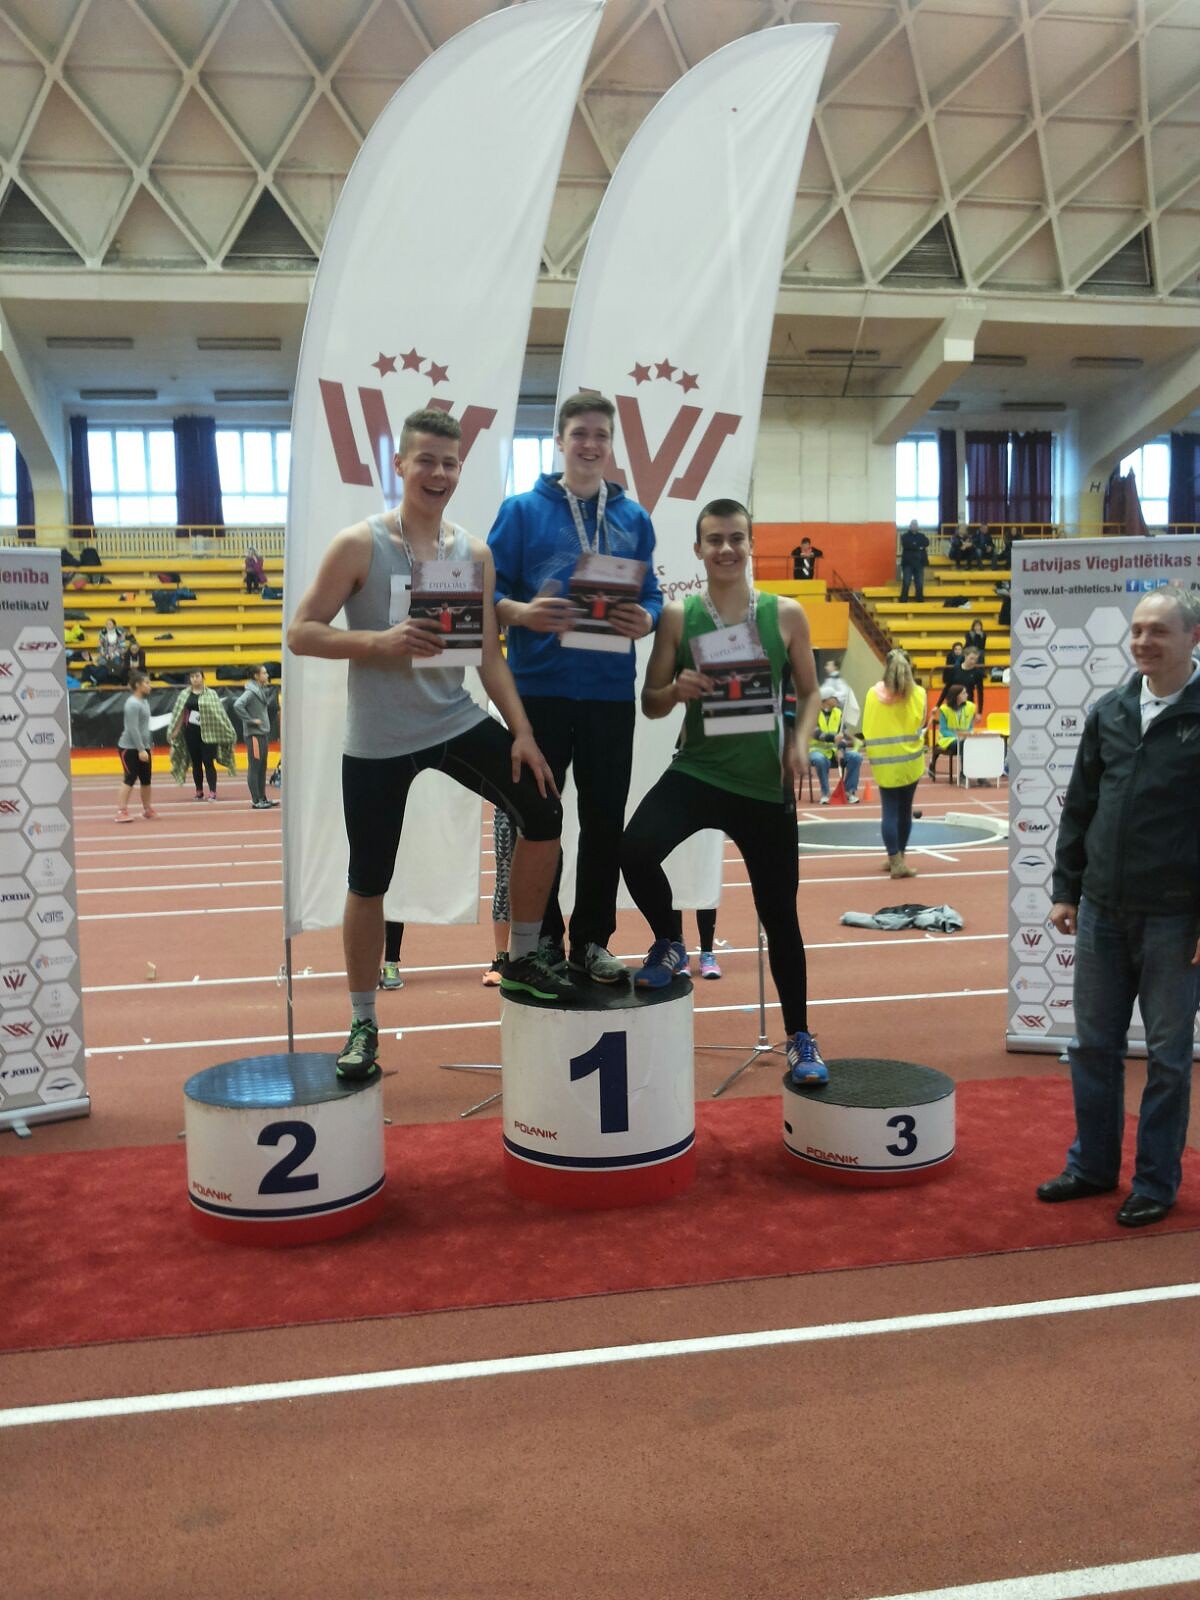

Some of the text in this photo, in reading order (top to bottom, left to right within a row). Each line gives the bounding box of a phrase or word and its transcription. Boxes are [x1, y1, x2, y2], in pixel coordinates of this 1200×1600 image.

[1022, 557, 1081, 574] Latvijas
[1086, 553, 1192, 573] Vieglatlētikas
[1023, 583, 1123, 596] www.lat-athletics.lv
[569, 1030, 630, 1134] 1
[514, 1120, 558, 1141] POLANIK
[885, 1113, 919, 1158] 3
[256, 1120, 320, 1196] 2
[806, 1145, 860, 1165] POLANIK
[192, 1181, 233, 1202] POLANIK
